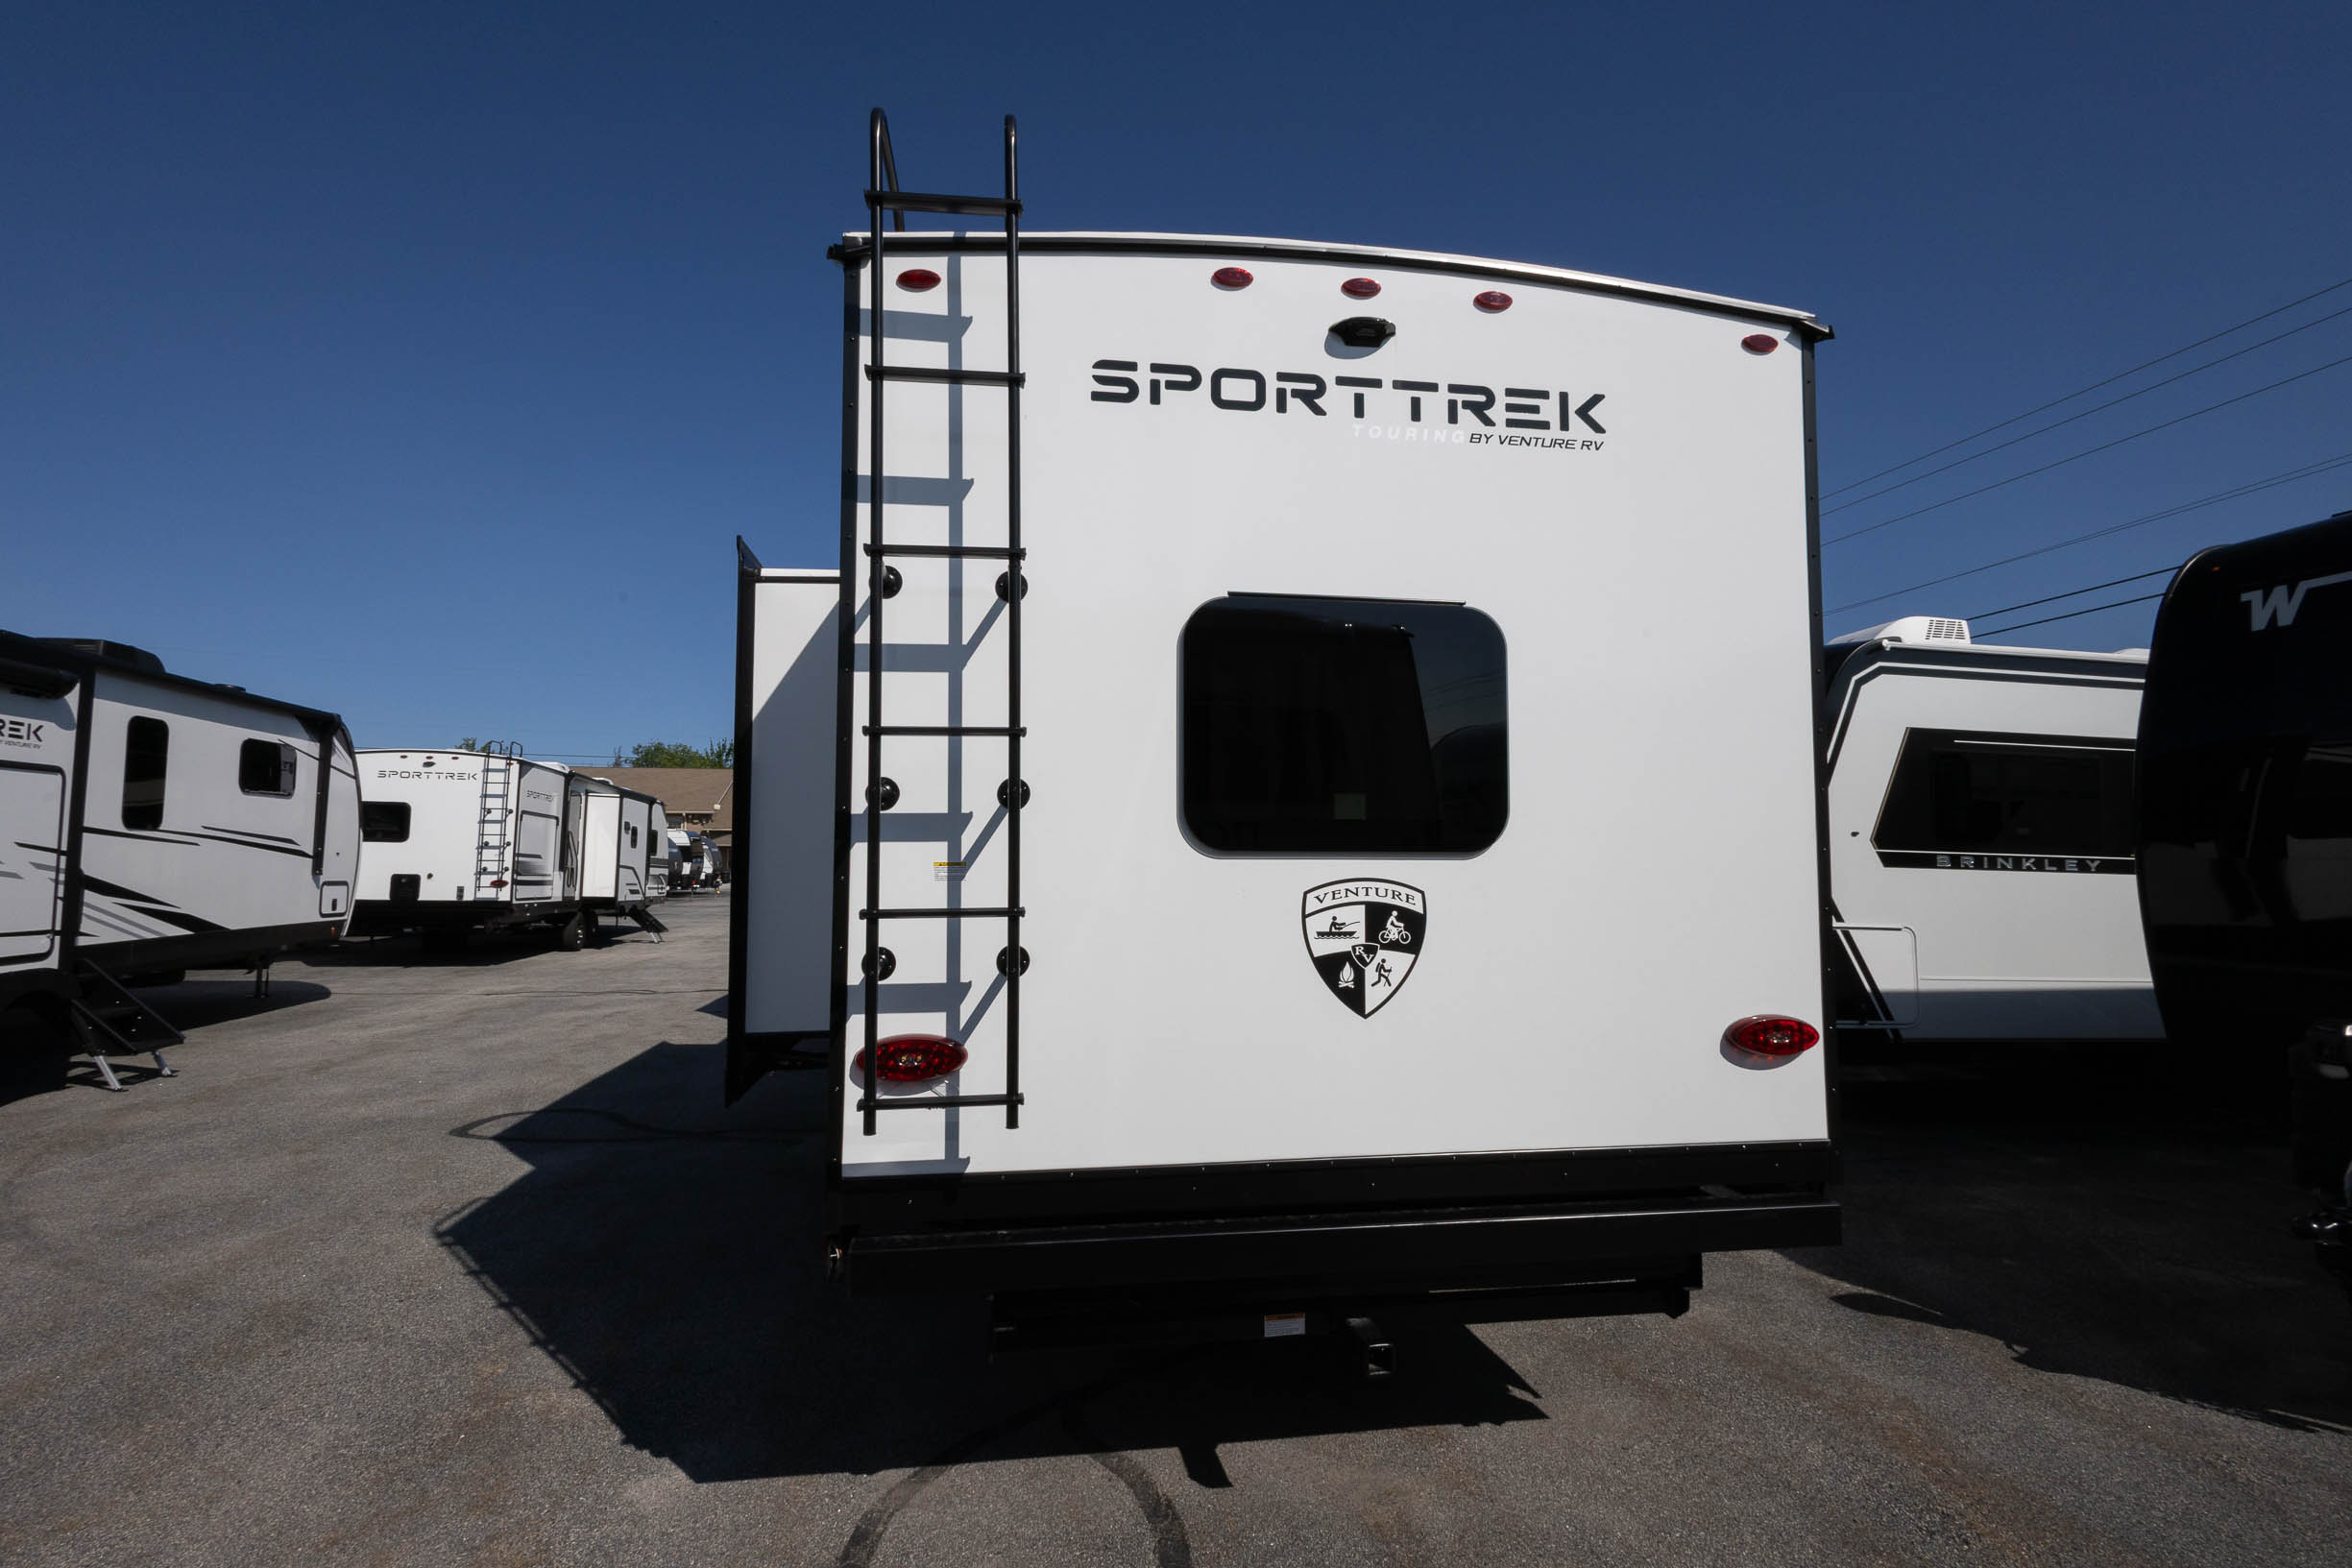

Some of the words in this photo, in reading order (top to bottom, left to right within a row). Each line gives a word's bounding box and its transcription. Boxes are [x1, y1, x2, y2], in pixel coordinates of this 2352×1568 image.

[1091, 359, 1607, 434] SPORTTREK
[1351, 423, 1466, 444] TOURING
[1468, 432, 1493, 445] BY
[1498, 434, 1577, 450] VENTURE
[1580, 439, 1605, 451] RV
[377, 770, 477, 781] SPORTTREK
[1936, 855, 2101, 872] BRINKLEY
[1314, 886, 1417, 906] VENTURE
